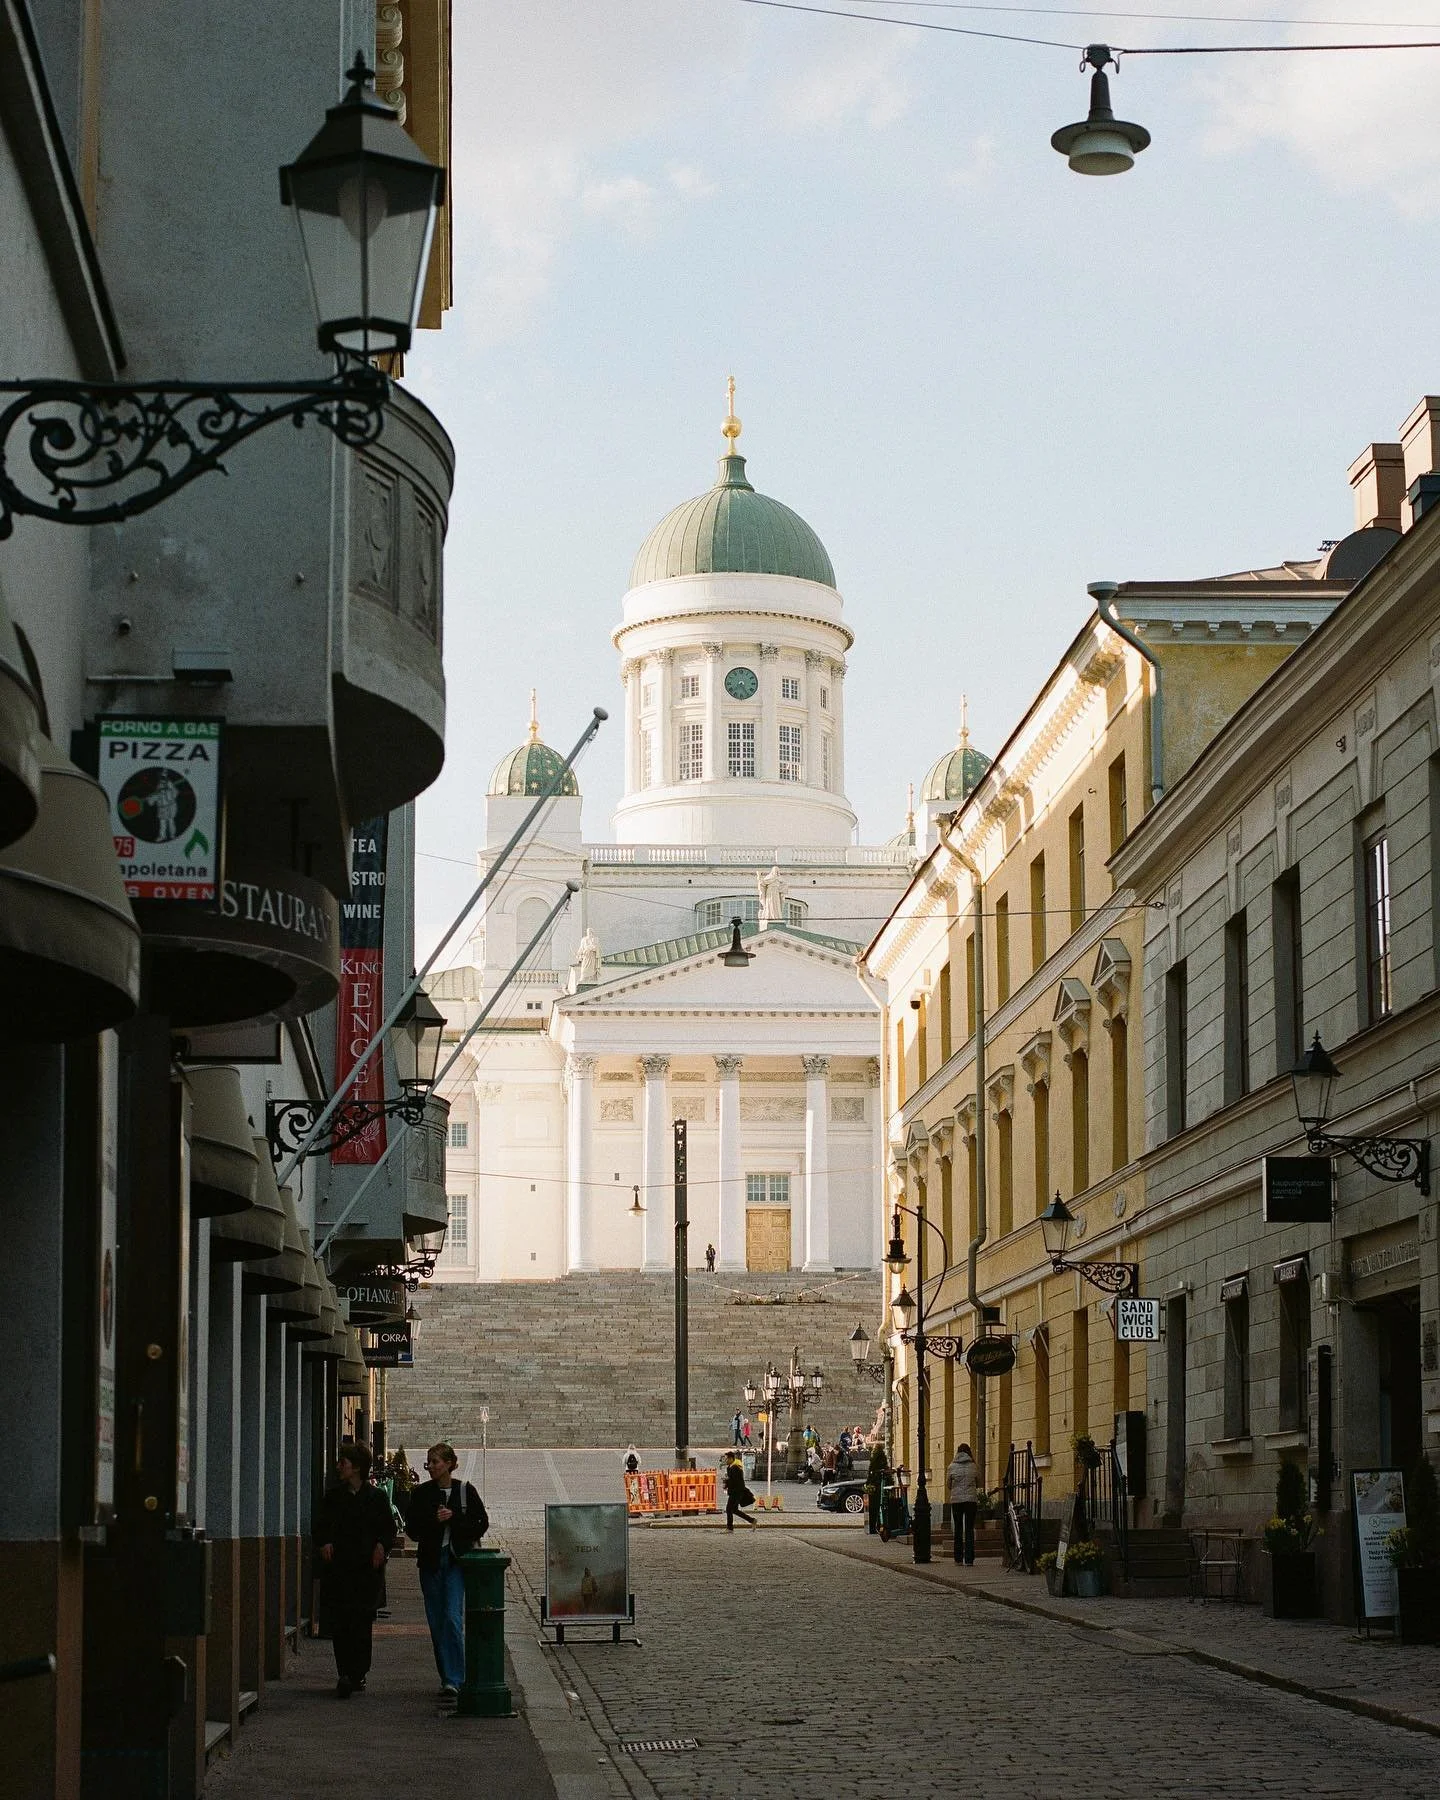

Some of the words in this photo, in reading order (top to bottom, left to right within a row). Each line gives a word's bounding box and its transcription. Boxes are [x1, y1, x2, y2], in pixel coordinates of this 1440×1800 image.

[101, 721, 162, 733] FORNO
[167, 722, 179, 734] A
[184, 722, 219, 735] GAS
[109, 741, 209, 761] PIZZA
[120, 863, 207, 878] apoletana
[352, 871, 386, 886] STRO
[153, 887, 217, 899] OVEN
[343, 904, 381, 919] WINE
[1121, 1301, 1153, 1313] SAND
[1121, 1314, 1153, 1325] WICH
[381, 1333, 408, 1342] OKRA
[1121, 1327, 1154, 1338] CLUB
